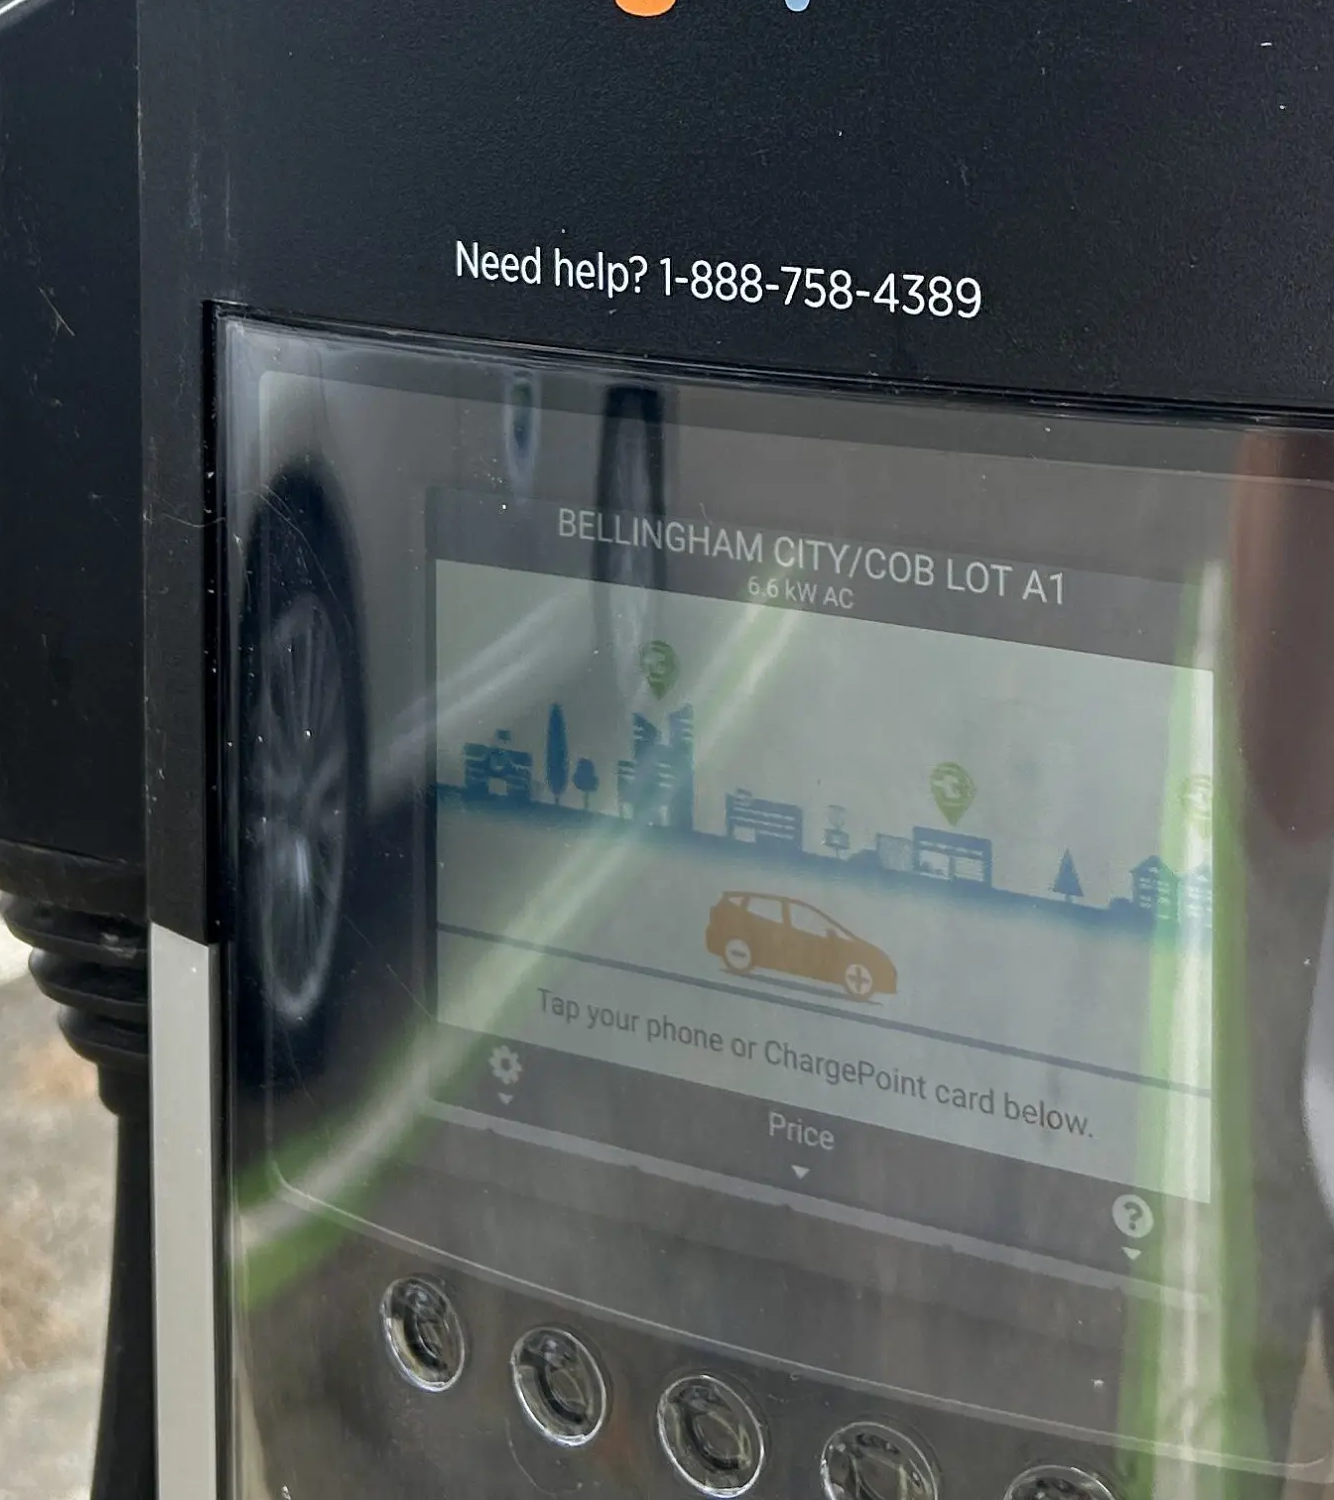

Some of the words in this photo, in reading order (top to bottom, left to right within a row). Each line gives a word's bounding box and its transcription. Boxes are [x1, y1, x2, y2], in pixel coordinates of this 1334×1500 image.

[454, 240, 542, 285] Need
[553, 247, 649, 299] help?
[659, 257, 982, 319] 1-888-758-4389
[557, 507, 764, 563] BELLINGHAM
[773, 535, 935, 587] CITY/COB
[946, 560, 1013, 597] LOT
[1021, 570, 1065, 606] A1
[747, 576, 780, 600] 6.6
[784, 578, 819, 605] kW
[823, 586, 856, 610] AC
[537, 987, 580, 1024] Tap
[586, 1002, 639, 1033] your
[646, 1006, 724, 1053] phone
[730, 1034, 758, 1061] or
[763, 1038, 928, 1100] ChargePoint
[934, 1083, 995, 1116] card
[1004, 1096, 1095, 1139] below.
[768, 1111, 836, 1152] Price
